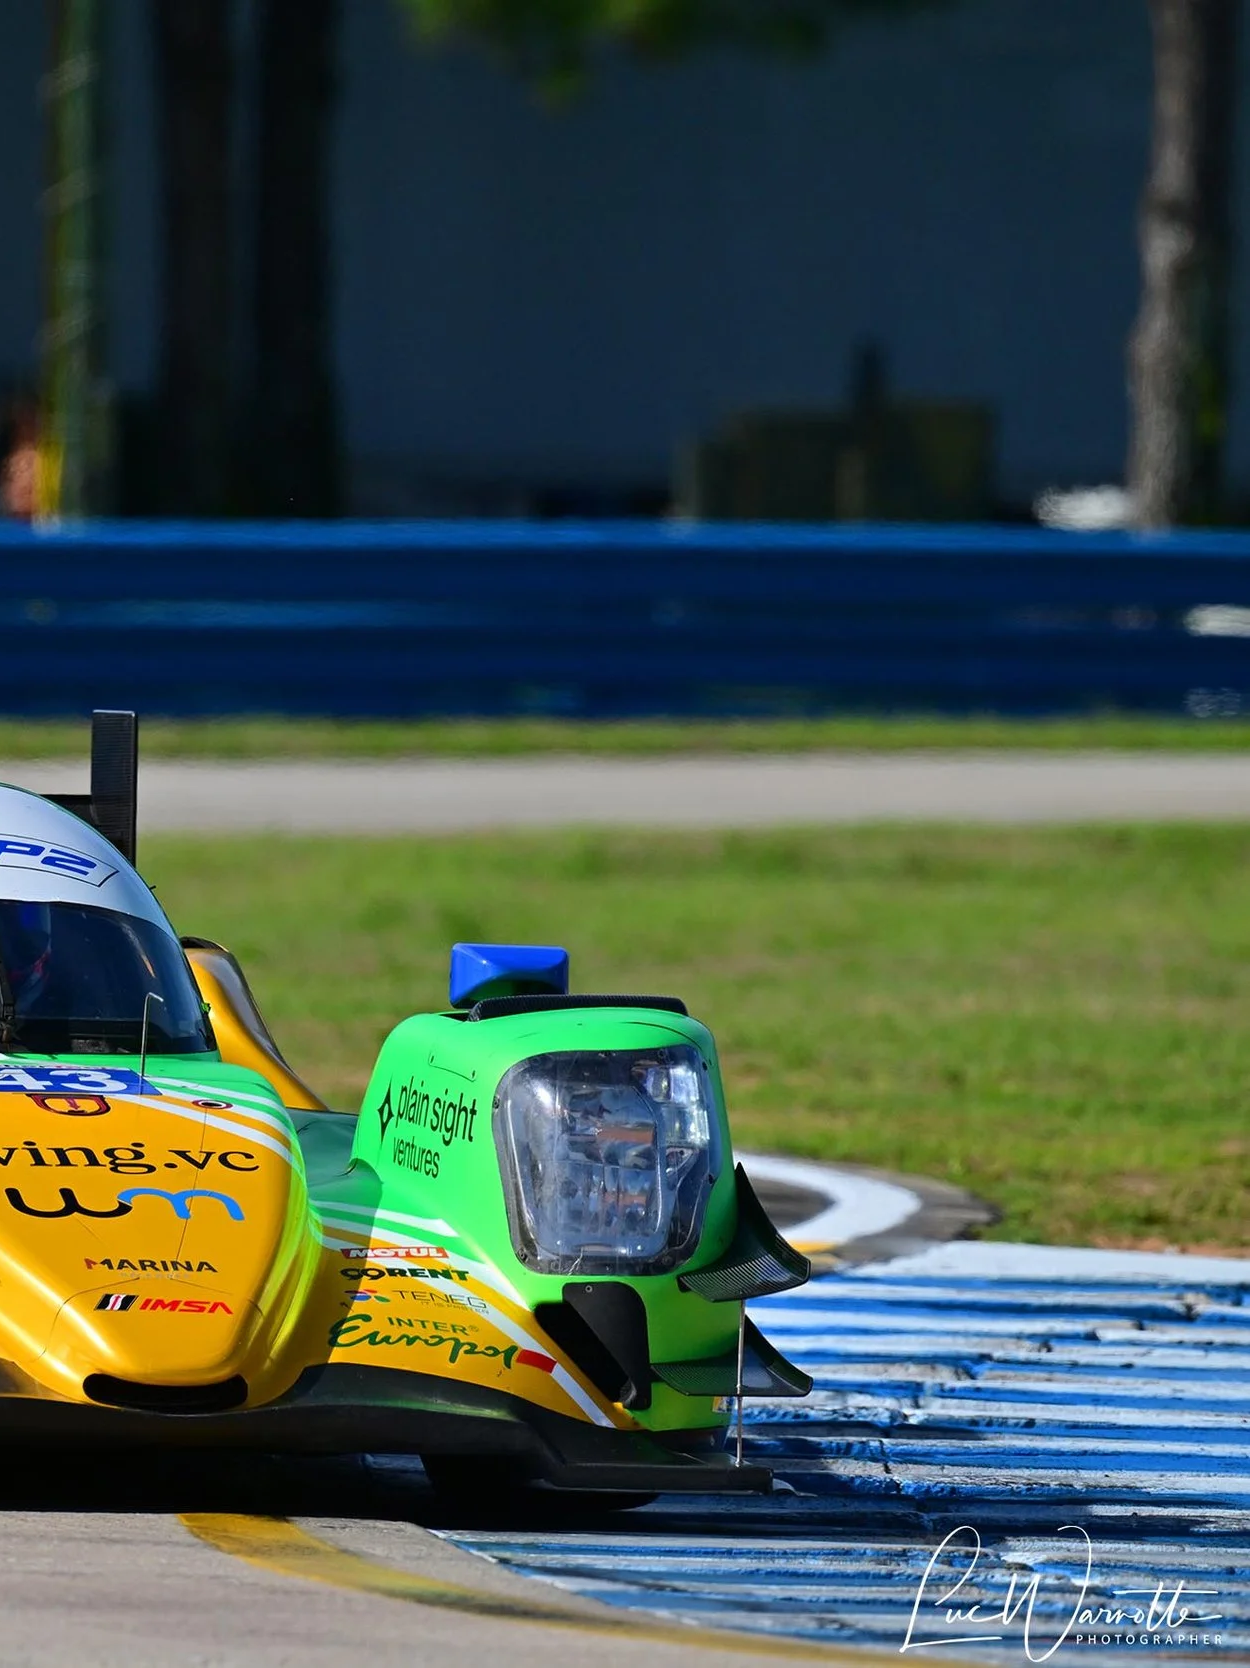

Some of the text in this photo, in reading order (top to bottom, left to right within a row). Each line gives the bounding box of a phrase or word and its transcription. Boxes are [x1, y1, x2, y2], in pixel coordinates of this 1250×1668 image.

[395, 1075, 478, 1147] plain sight
[392, 1135, 441, 1179] ventures
[349, 1247, 444, 1258] MOTUL
[84, 1257, 219, 1273] MARINA
[340, 1267, 469, 1282] 99RENT
[139, 1297, 234, 1316] IMSA
[391, 1290, 487, 1309] TENEG
[328, 1313, 518, 1370] Europol
